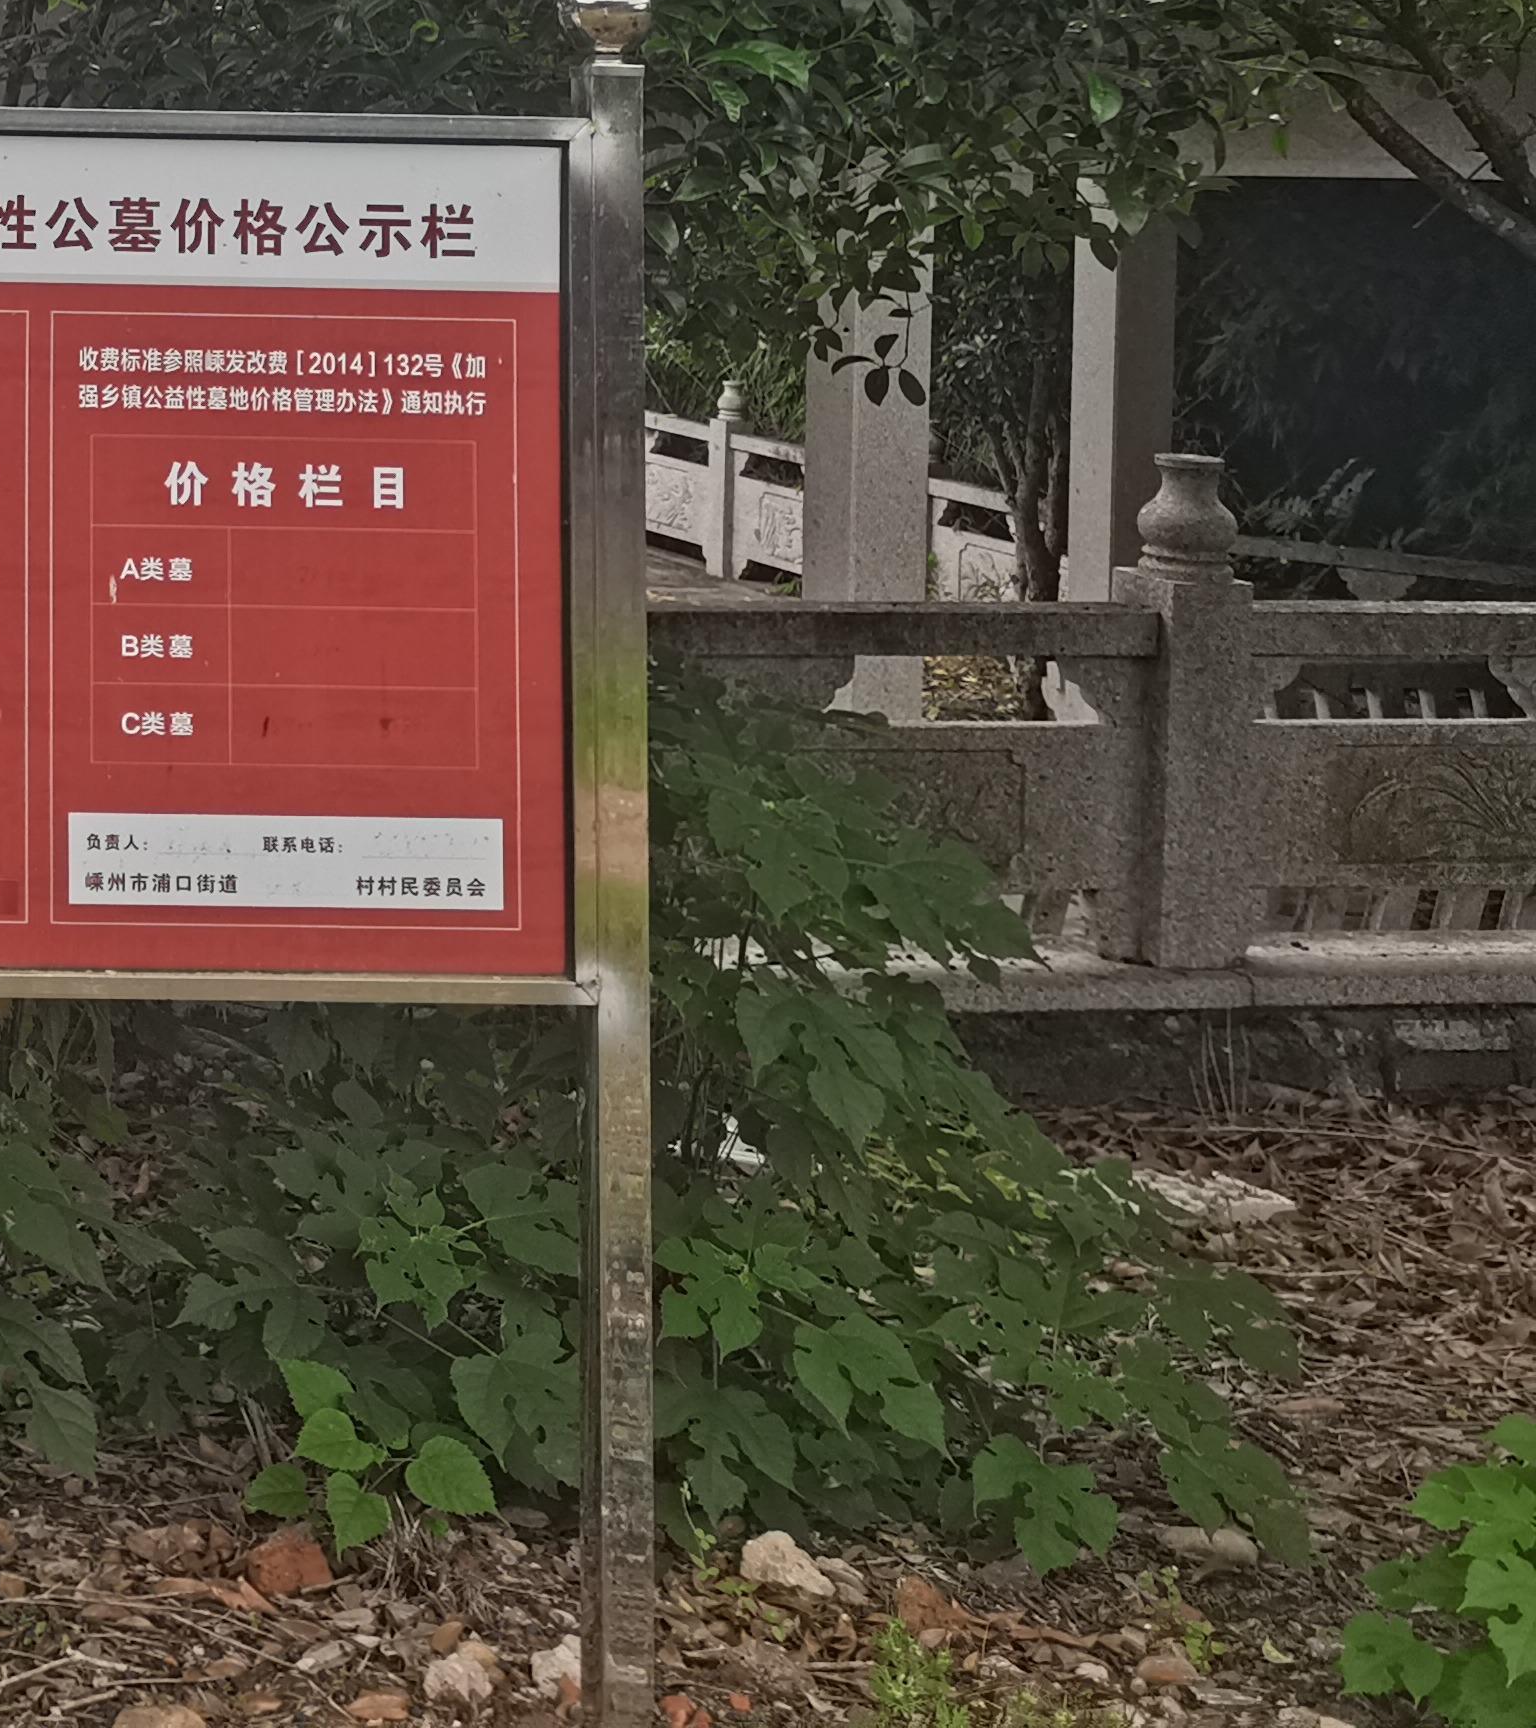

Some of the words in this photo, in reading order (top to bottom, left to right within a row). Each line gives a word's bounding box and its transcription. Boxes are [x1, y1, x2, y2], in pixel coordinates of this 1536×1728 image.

[164, 461, 403, 509] 价格栏目
[120, 558, 192, 581] A类墓
[122, 634, 192, 658] B类墓
[122, 712, 193, 735] C类墓
[87, 834, 147, 850] 负责人：
[263, 837, 341, 853] 联系电话：
[85, 873, 237, 893] 嵊州市浦口街道
[357, 876, 485, 896] 村村民委员会
